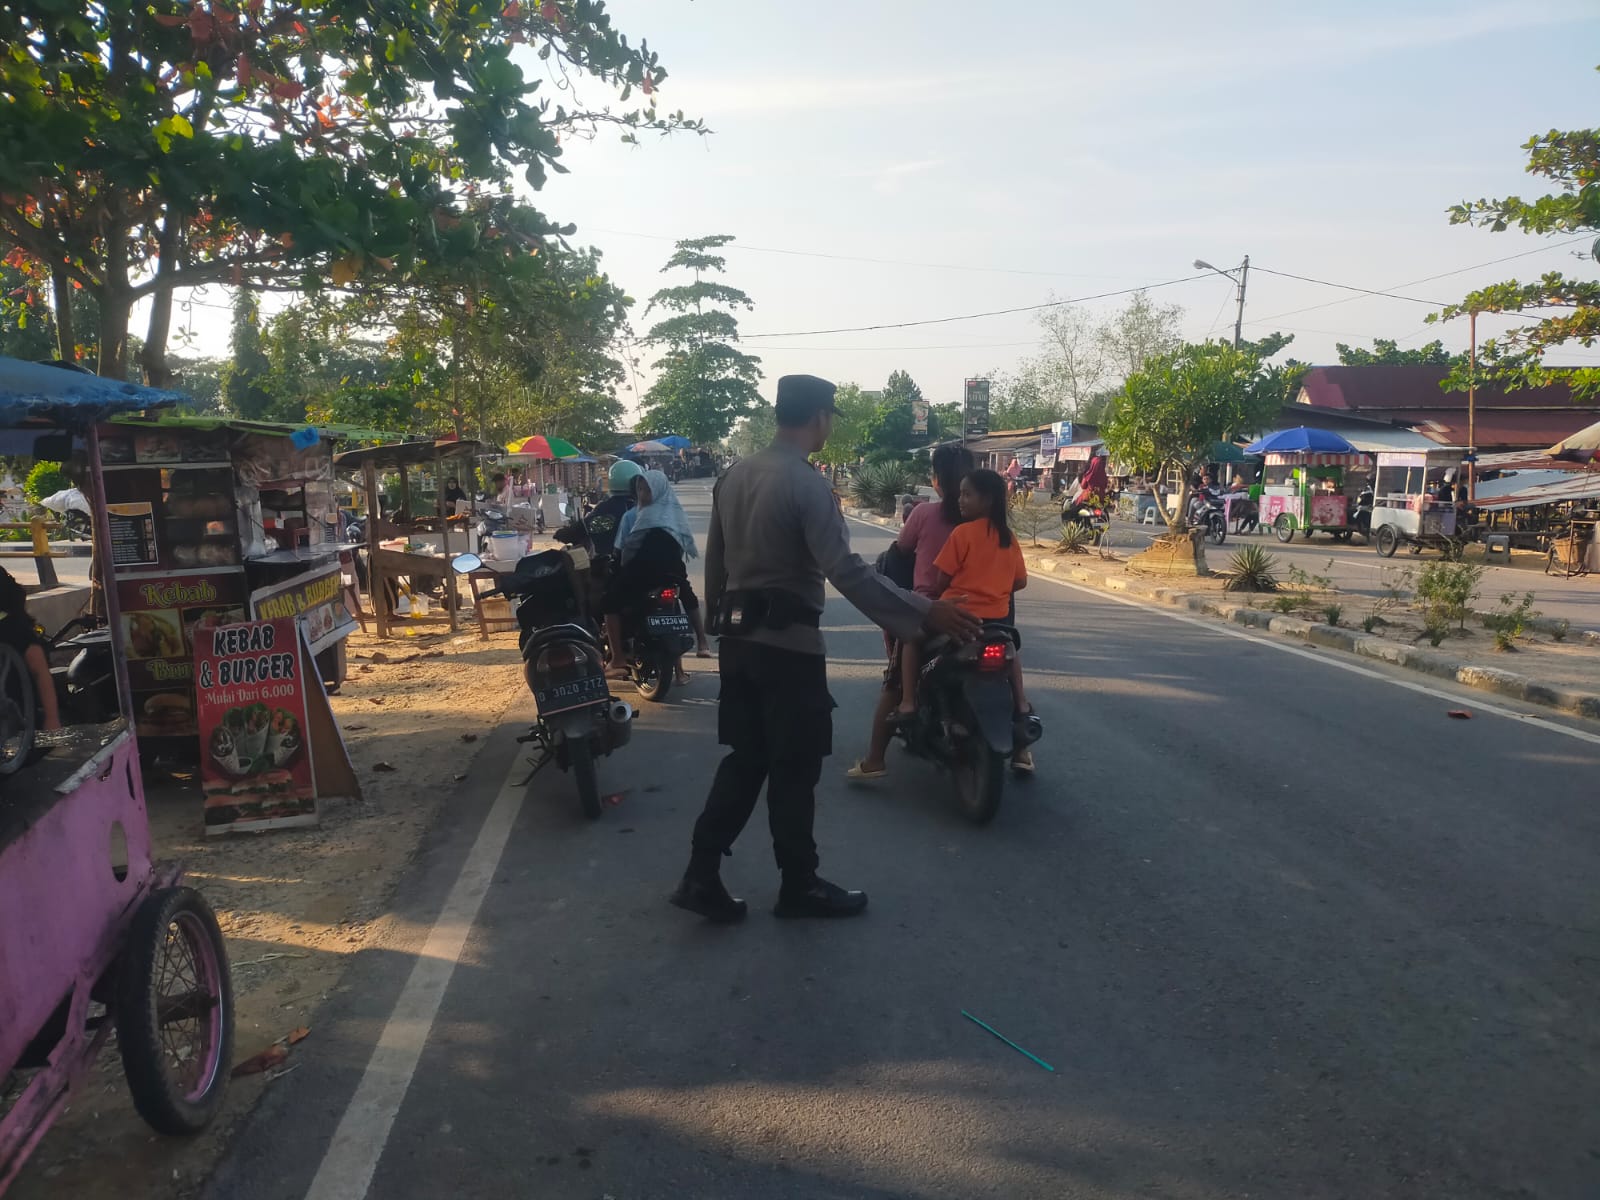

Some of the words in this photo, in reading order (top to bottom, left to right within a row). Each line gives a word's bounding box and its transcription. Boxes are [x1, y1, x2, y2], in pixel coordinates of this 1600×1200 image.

[140, 580, 216, 608] Kebab
[259, 593, 296, 619] KEBAB
[295, 593, 306, 615] &
[304, 574, 341, 607] BURGER
[213, 624, 274, 657] KEBAB
[199, 660, 214, 689] &
[218, 652, 294, 687] BURGER
[205, 688, 235, 705] Mulai
[236, 687, 260, 702] Dari
[261, 683, 295, 699] 6.000
